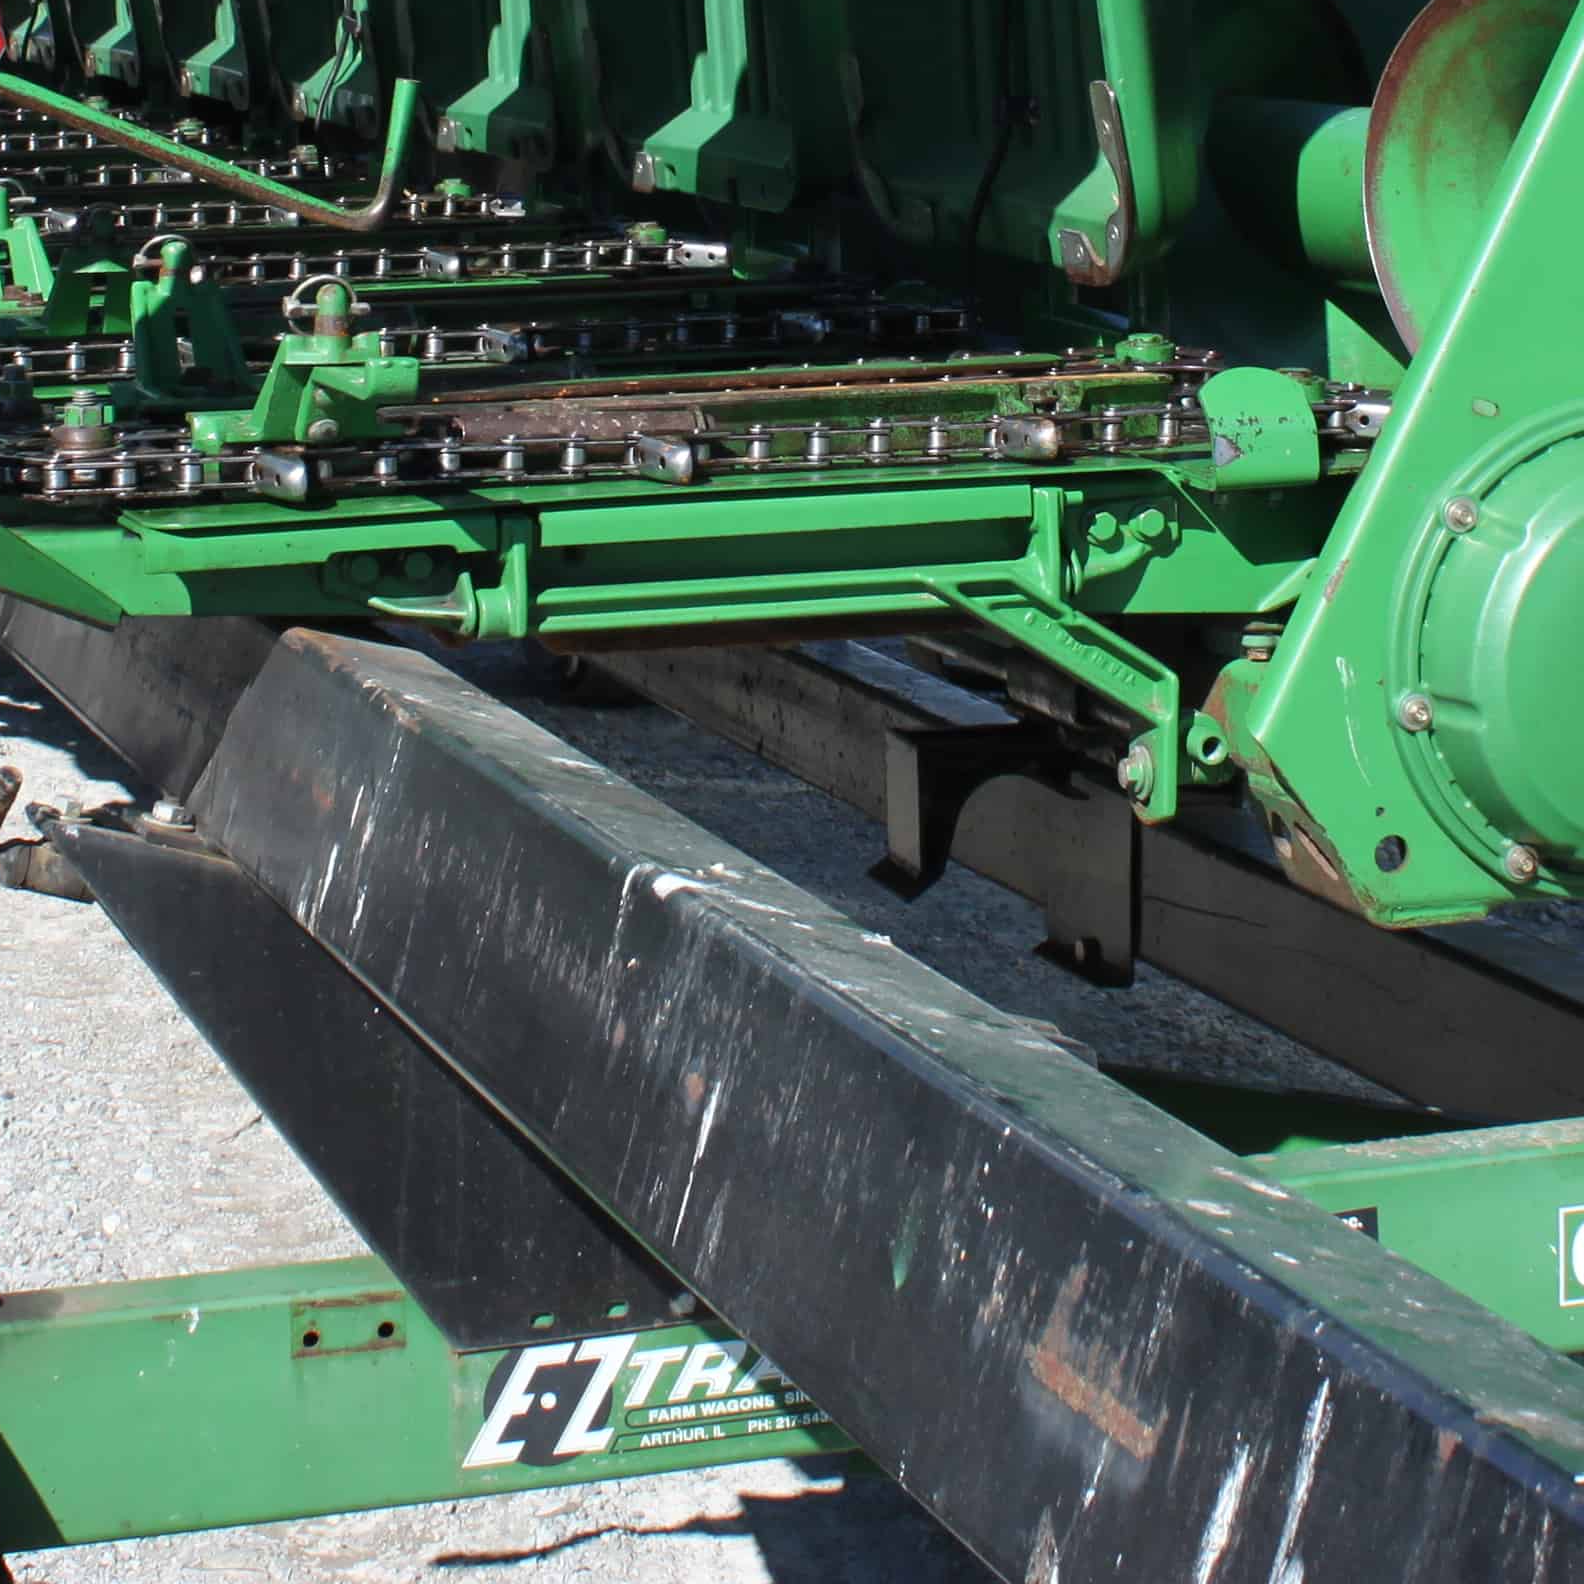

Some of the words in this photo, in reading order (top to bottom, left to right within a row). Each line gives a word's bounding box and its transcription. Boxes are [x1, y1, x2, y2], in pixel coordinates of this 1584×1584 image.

[648, 1405, 695, 1423] FARM
[700, 1395, 775, 1417] WAGONS
[713, 1424, 726, 1438] IL
[748, 1417, 773, 1433] PH:
